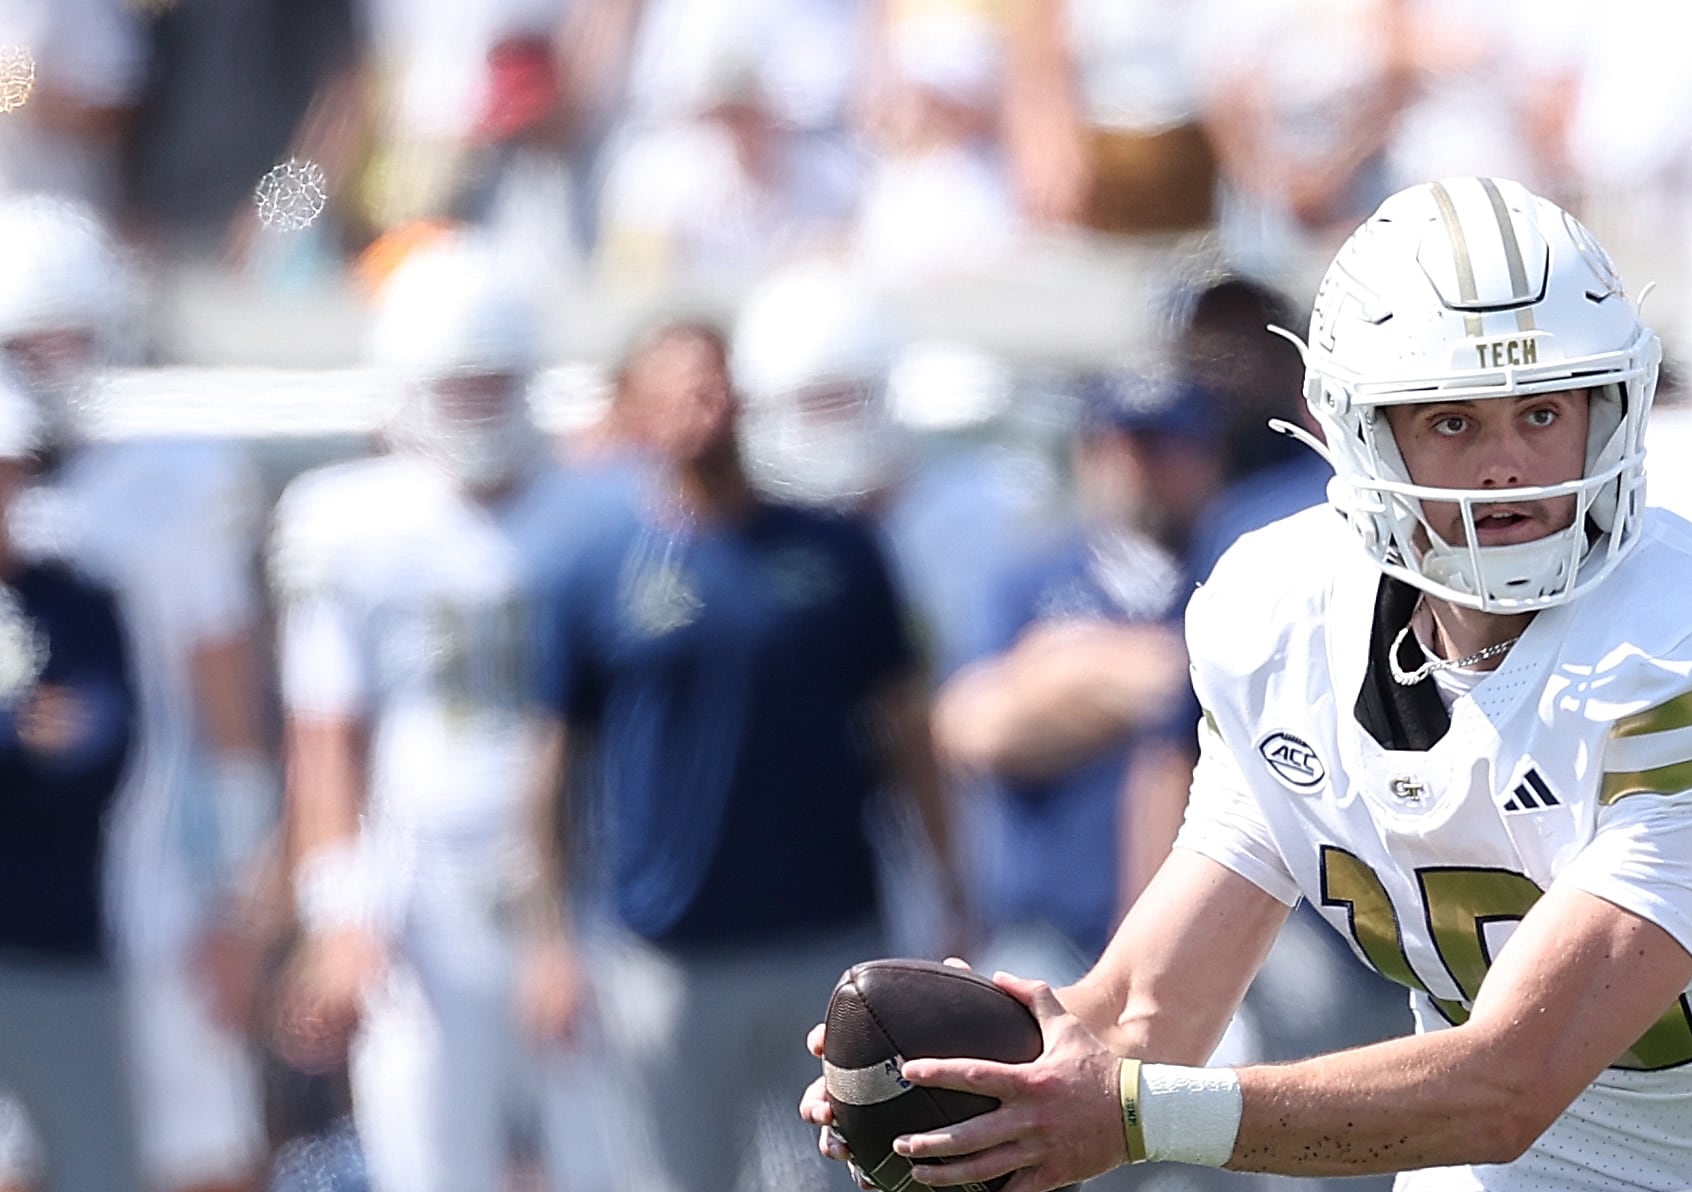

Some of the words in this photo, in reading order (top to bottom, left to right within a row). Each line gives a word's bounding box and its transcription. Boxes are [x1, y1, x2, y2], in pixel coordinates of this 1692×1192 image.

[1476, 338, 1537, 368] TECH
[1271, 745, 1317, 773] ACC
[1390, 775, 1426, 802] GT
